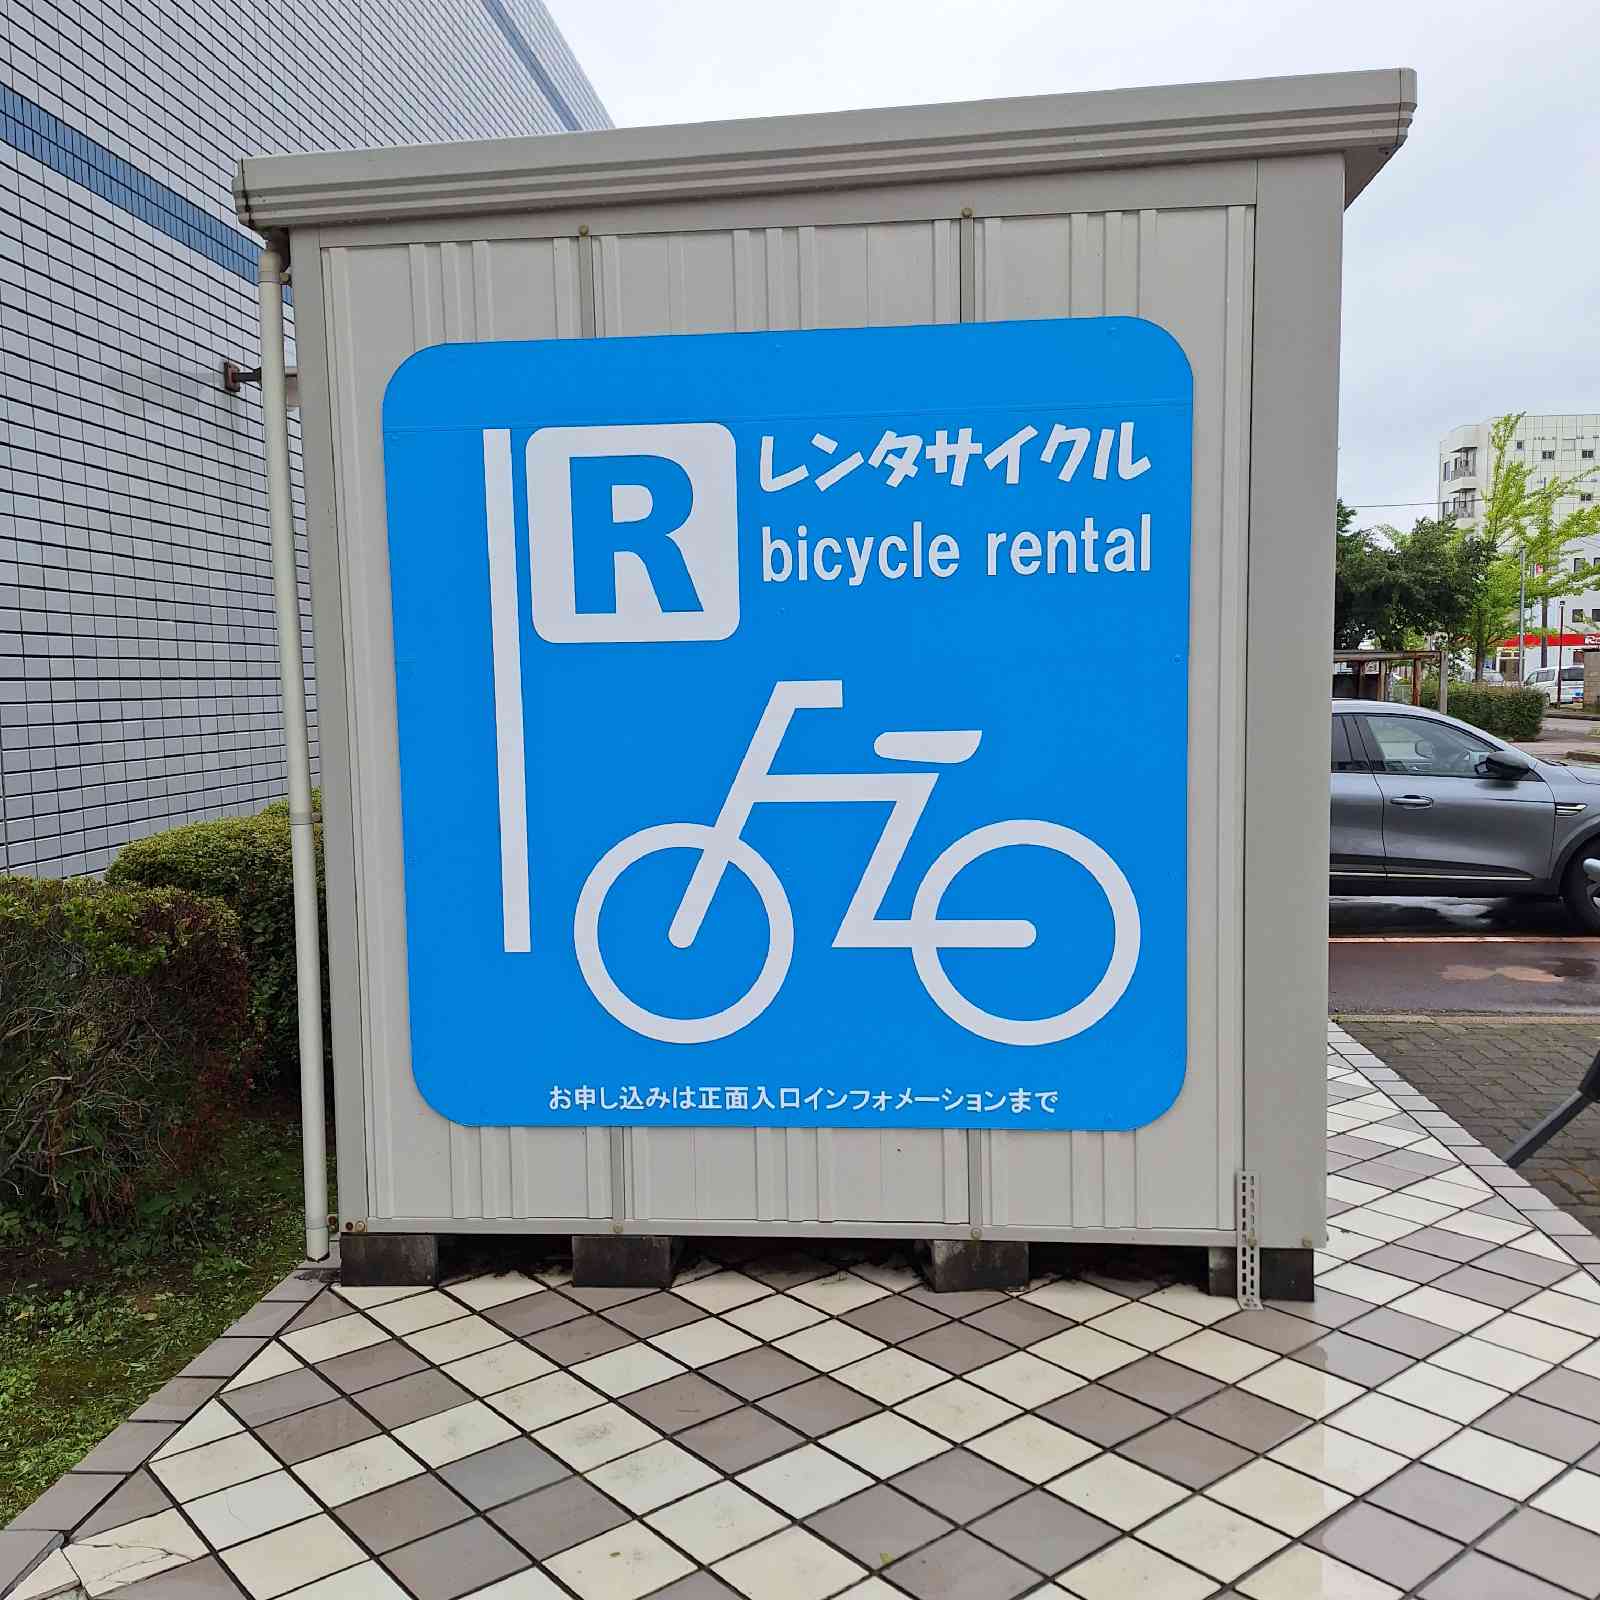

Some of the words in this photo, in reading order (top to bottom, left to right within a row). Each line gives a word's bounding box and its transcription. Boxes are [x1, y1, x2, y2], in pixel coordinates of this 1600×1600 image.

[759, 421, 1152, 492] レンタサイクル
[568, 455, 705, 615] R
[762, 521, 960, 587] bicycle
[987, 513, 1152, 576] rental
[548, 1085, 1059, 1114] お申し込みは正面入口インフォメーションまで
